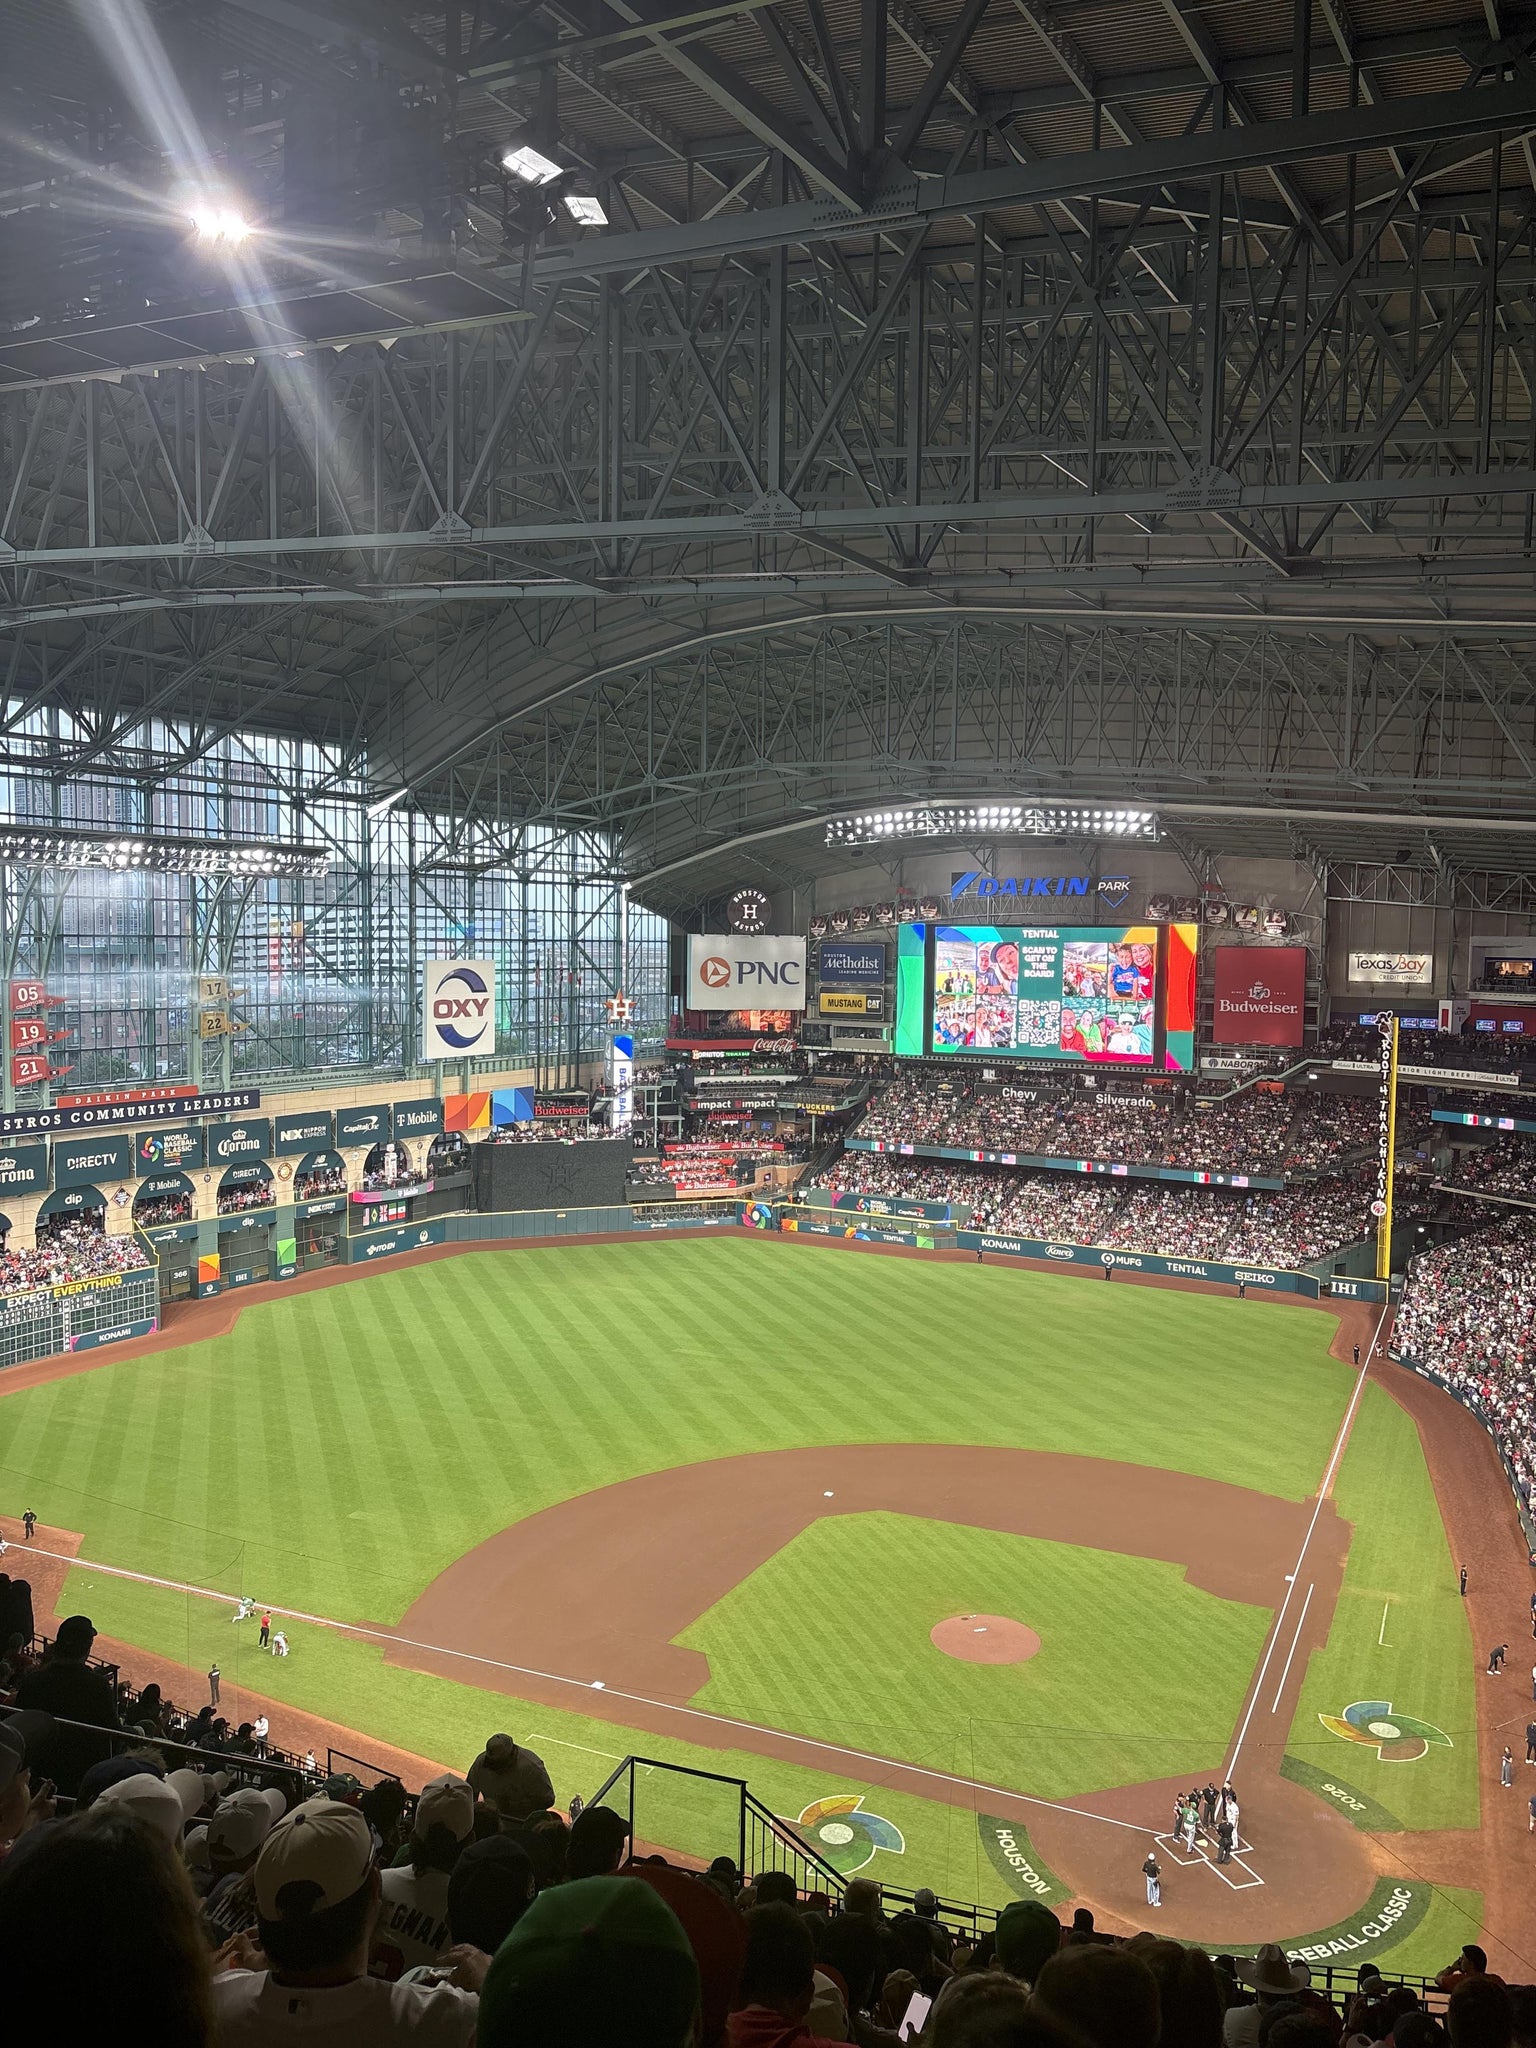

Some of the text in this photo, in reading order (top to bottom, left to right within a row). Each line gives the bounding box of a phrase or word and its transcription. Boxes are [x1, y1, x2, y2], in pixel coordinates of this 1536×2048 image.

[977, 876, 1131, 897] DAIKIN PARK
[733, 890, 767, 903] HOUSTON
[742, 904, 758, 919] H
[854, 906, 868, 919] 25
[734, 920, 765, 931] ASTROS
[1022, 929, 1060, 939] TENTIAL
[1022, 946, 1058, 954] SCAN TO
[824, 956, 880, 970] Methodist
[1041, 954, 1055, 962] ON
[1354, 955, 1427, 974] Texas Bay
[1031, 962, 1048, 970] THE
[734, 961, 800, 985] PNC
[1401, 974, 1424, 982] UNION
[17, 986, 39, 1002] 05
[207, 982, 222, 996] 17
[433, 998, 490, 1019] OXY
[827, 999, 881, 1009] MUSTANG CAT
[207, 1018, 222, 1030] 22
[20, 1026, 40, 1040] 19
[1380, 1039, 1392, 1080] ROOT
[20, 1061, 39, 1076] 21
[1424, 1069, 1447, 1077] LIGHT
[75, 1089, 176, 1105] DAIKIN PARK
[1002, 1087, 1038, 1101] Chevy
[1379, 1085, 1389, 1096] 4
[697, 1100, 732, 1109] impact
[742, 1099, 776, 1108] impact
[797, 1102, 836, 1111] PLUCKERS
[1095, 1093, 1154, 1108] Silverado
[70, 1102, 177, 1124] COMMUNITY
[183, 1095, 251, 1112] LEADERS
[535, 1105, 589, 1116] Budweiser
[1378, 1099, 1389, 1133] THA
[407, 1110, 438, 1126] Mobile
[303, 1125, 326, 1134] NIPPON
[303, 1130, 327, 1139] EXPRESS
[163, 1133, 189, 1142] WORLD
[163, 1138, 198, 1149] BASEBALL
[163, 1145, 193, 1155] CLASSIC
[217, 1138, 261, 1157] Corona
[685, 1143, 721, 1151] Budweiser
[66, 1152, 118, 1170] DIRECTV
[232, 1167, 261, 1179] DIRECTV
[1376, 1136, 1389, 1200] CHIKIN
[0, 1168, 35, 1184] rona
[156, 1179, 181, 1191] Mobile
[693, 1180, 730, 1189] Budweiser
[64, 1192, 83, 1206] dip
[241, 1217, 255, 1227] dip
[917, 1221, 930, 1230] 370
[981, 1237, 1021, 1251] KONAMI
[1047, 1246, 1074, 1258] Kowa
[1115, 1255, 1142, 1267] MUFG
[173, 1270, 188, 1279] 366
[1166, 1261, 1208, 1277] TENTIAL
[235, 1273, 248, 1283] IHI
[1234, 1270, 1276, 1285] SEIKO
[6, 1290, 52, 1308] EXPECT
[53, 1275, 123, 1298] EVERYTHING
[1330, 1281, 1358, 1296] IHI
[98, 1327, 132, 1342] KONAMI
[1320, 1782, 1367, 1812] 2026
[995, 1828, 1052, 1895] HOUSTON
[1287, 1886, 1413, 1963] SEBALL CLASSIC
